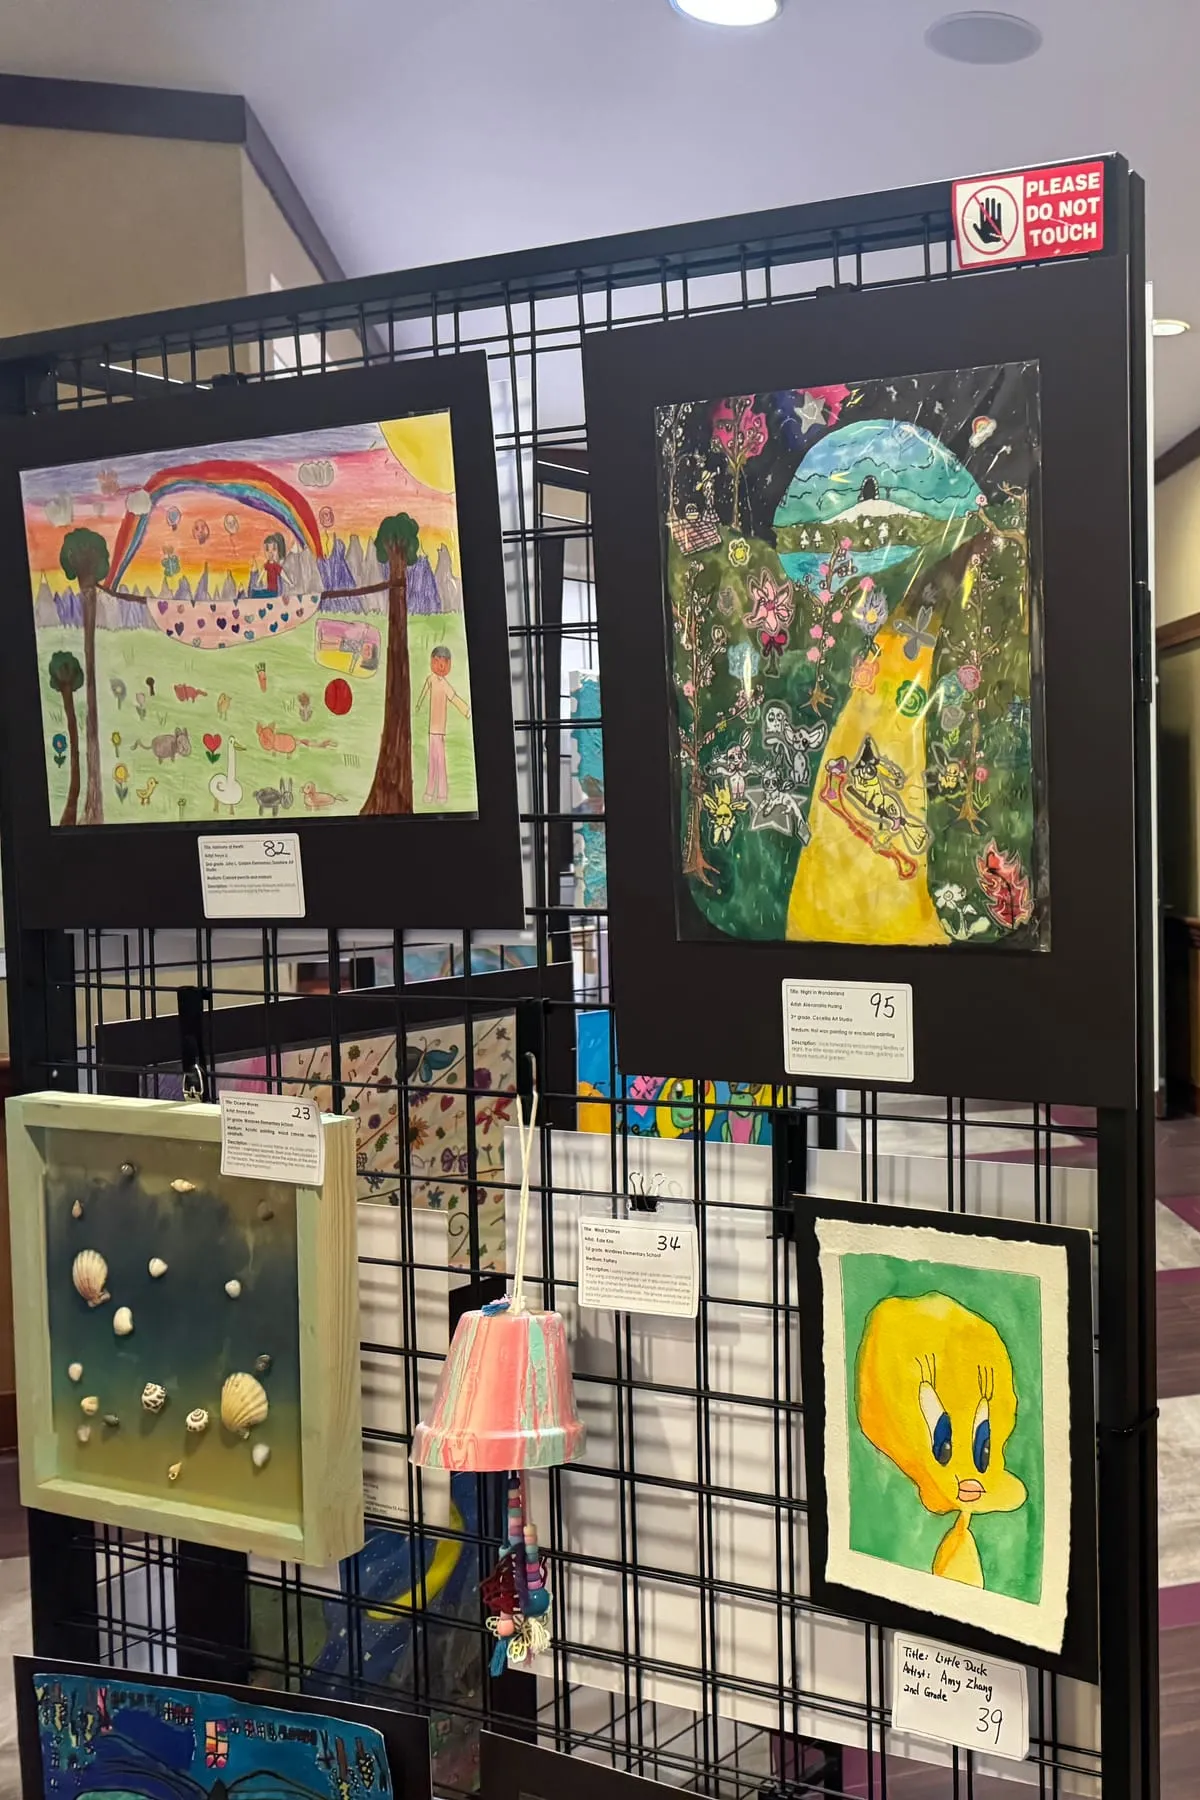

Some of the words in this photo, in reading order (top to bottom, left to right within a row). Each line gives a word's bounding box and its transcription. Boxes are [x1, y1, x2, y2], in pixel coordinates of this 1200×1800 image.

[1026, 172, 1100, 198] PLEASE
[1026, 204, 1053, 223] DO
[1059, 197, 1100, 218] NOT
[1029, 221, 1097, 247] TOUCH
[263, 840, 291, 857] 82
[870, 992, 895, 1019] 95
[291, 1107, 311, 1120] 23
[657, 1235, 681, 1251] 34
[903, 1646, 928, 1661] Title:
[935, 1651, 960, 1669] Little
[963, 1659, 988, 1677] Duck
[903, 1661, 930, 1679] Artist:
[940, 1670, 961, 1693] Amy
[966, 1677, 993, 1703] Zhang
[903, 1682, 920, 1696] 2nd
[924, 1686, 948, 1702] Grade
[976, 1707, 1003, 1745] 39
